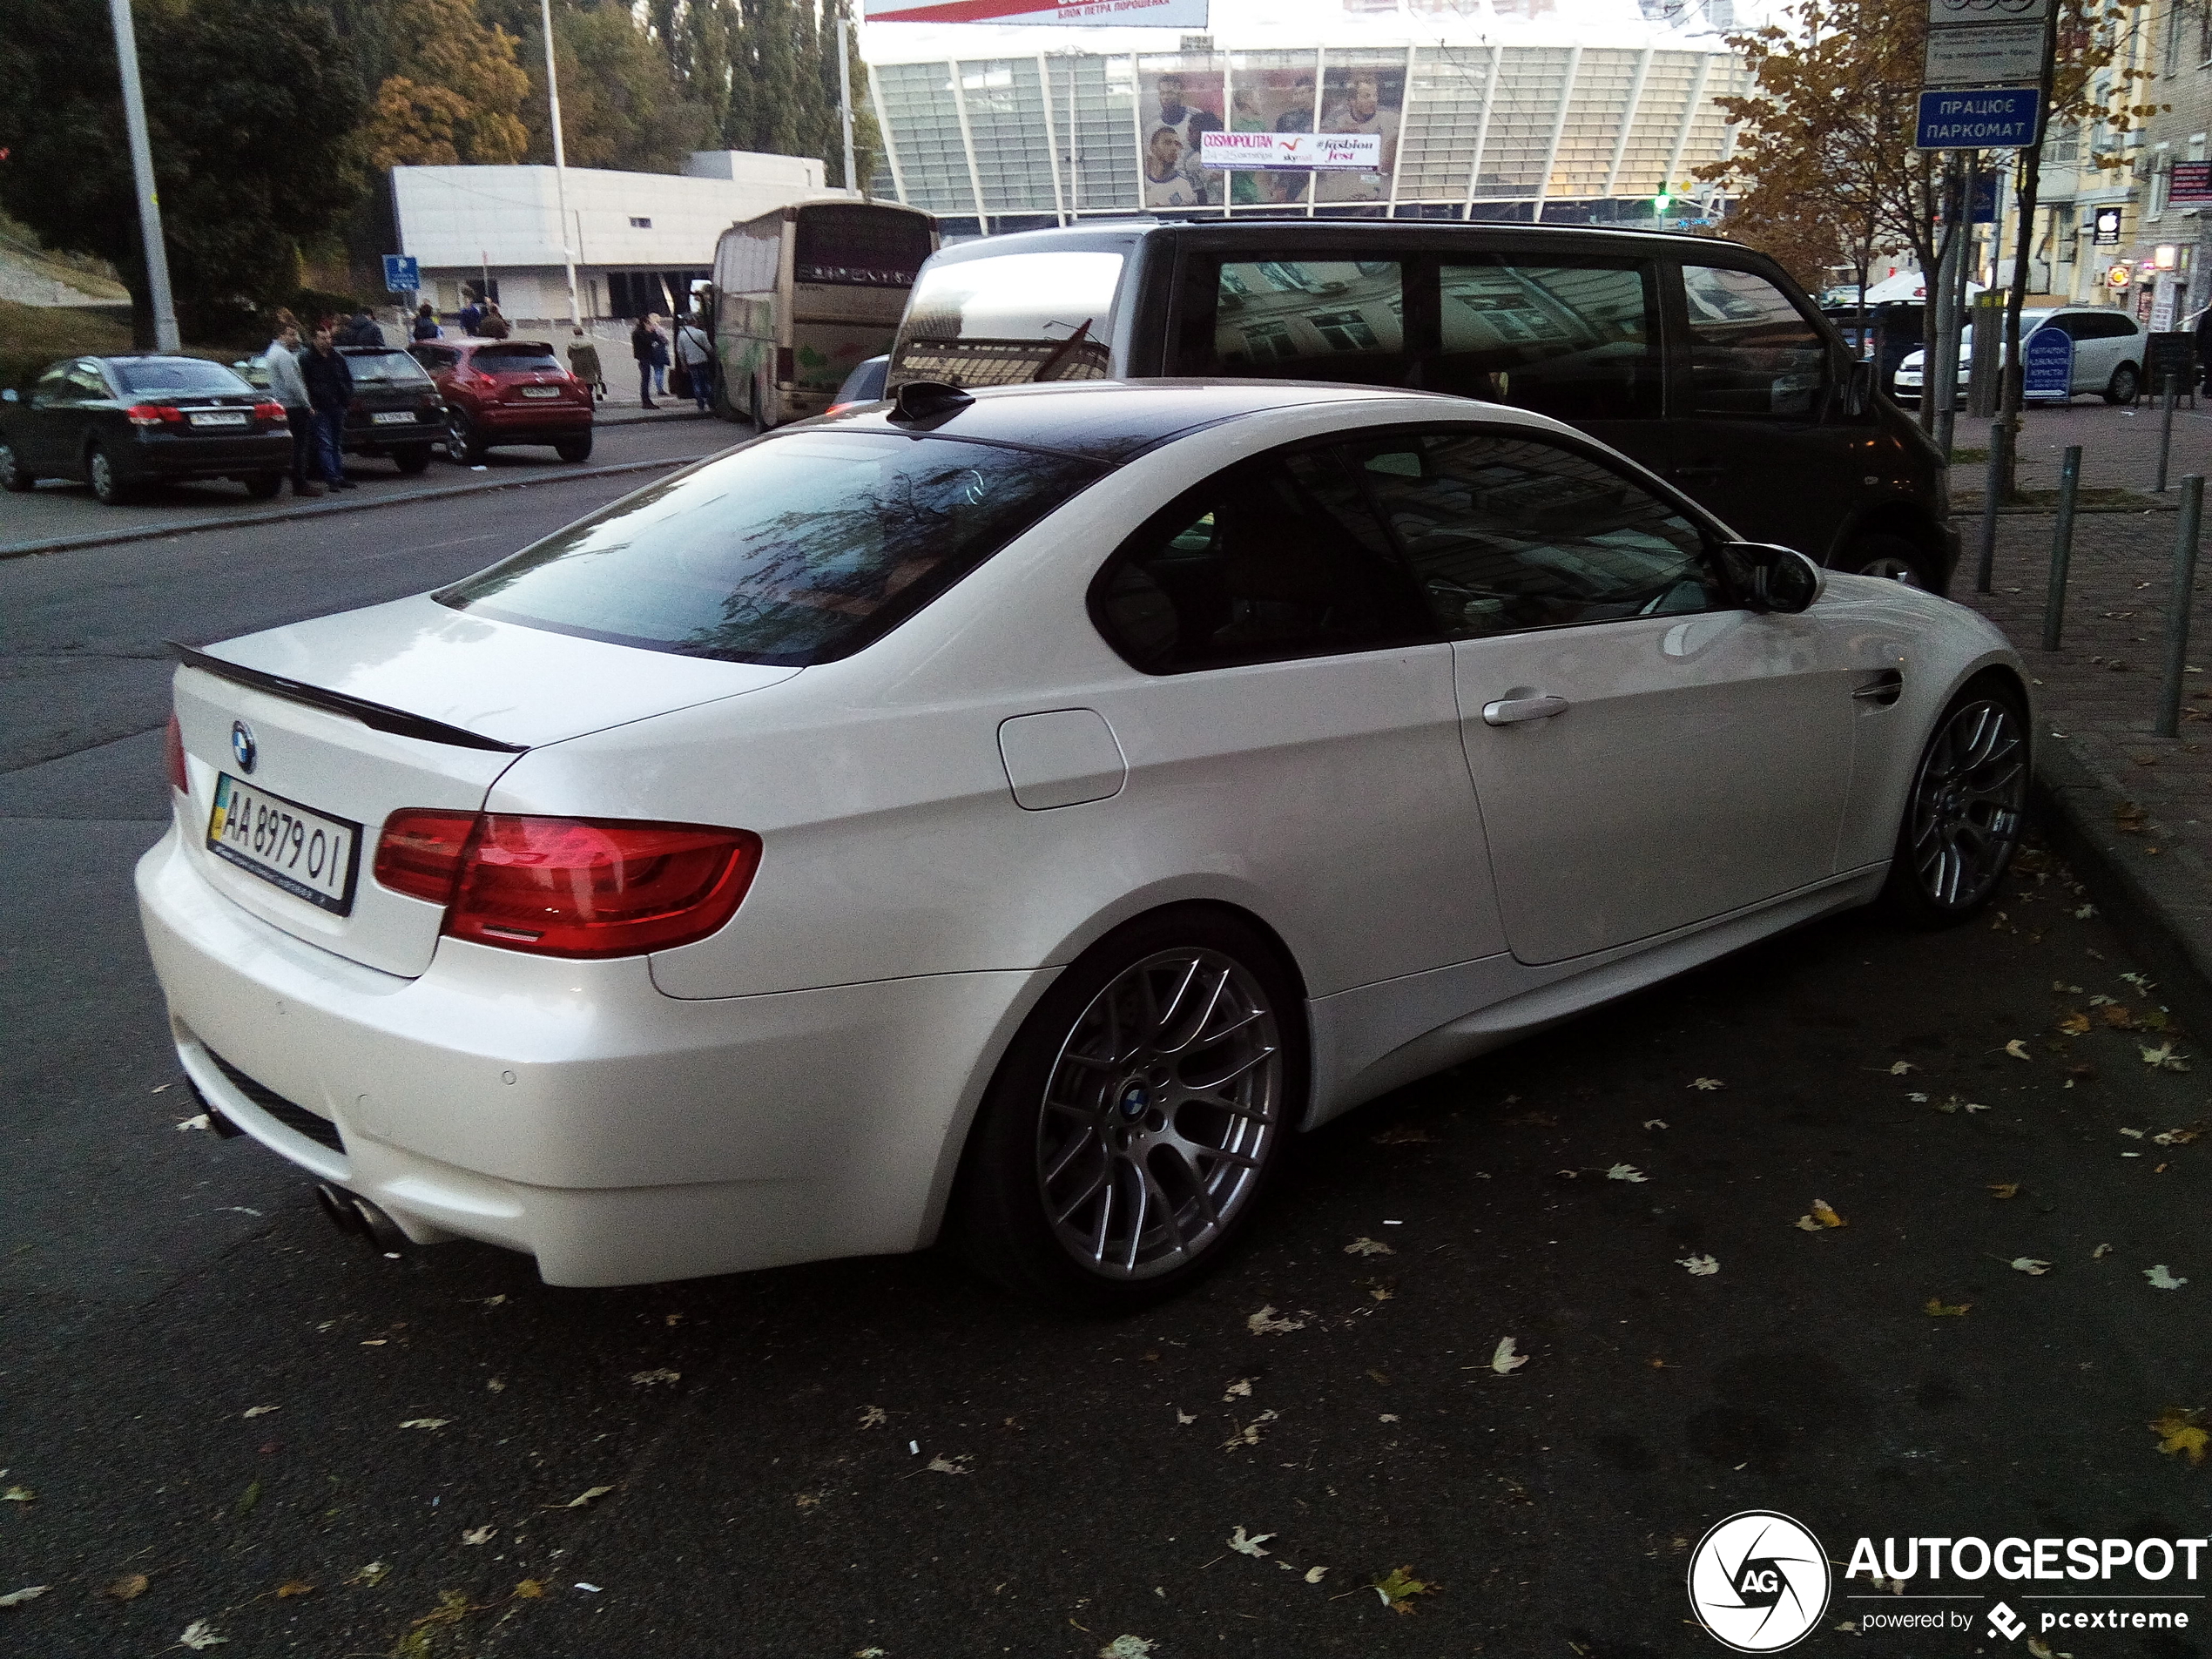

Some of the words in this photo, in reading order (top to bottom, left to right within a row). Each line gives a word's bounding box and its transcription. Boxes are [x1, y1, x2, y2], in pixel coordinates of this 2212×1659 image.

[1084, 3, 1112, 16] ПЕТРА
[1939, 98, 2015, 115] ПРАЦЮЄ
[1926, 122, 2026, 138] ПАРКОМАТ
[1204, 133, 1273, 148] COSMOPOLITAN
[253, 804, 304, 868] 8979
